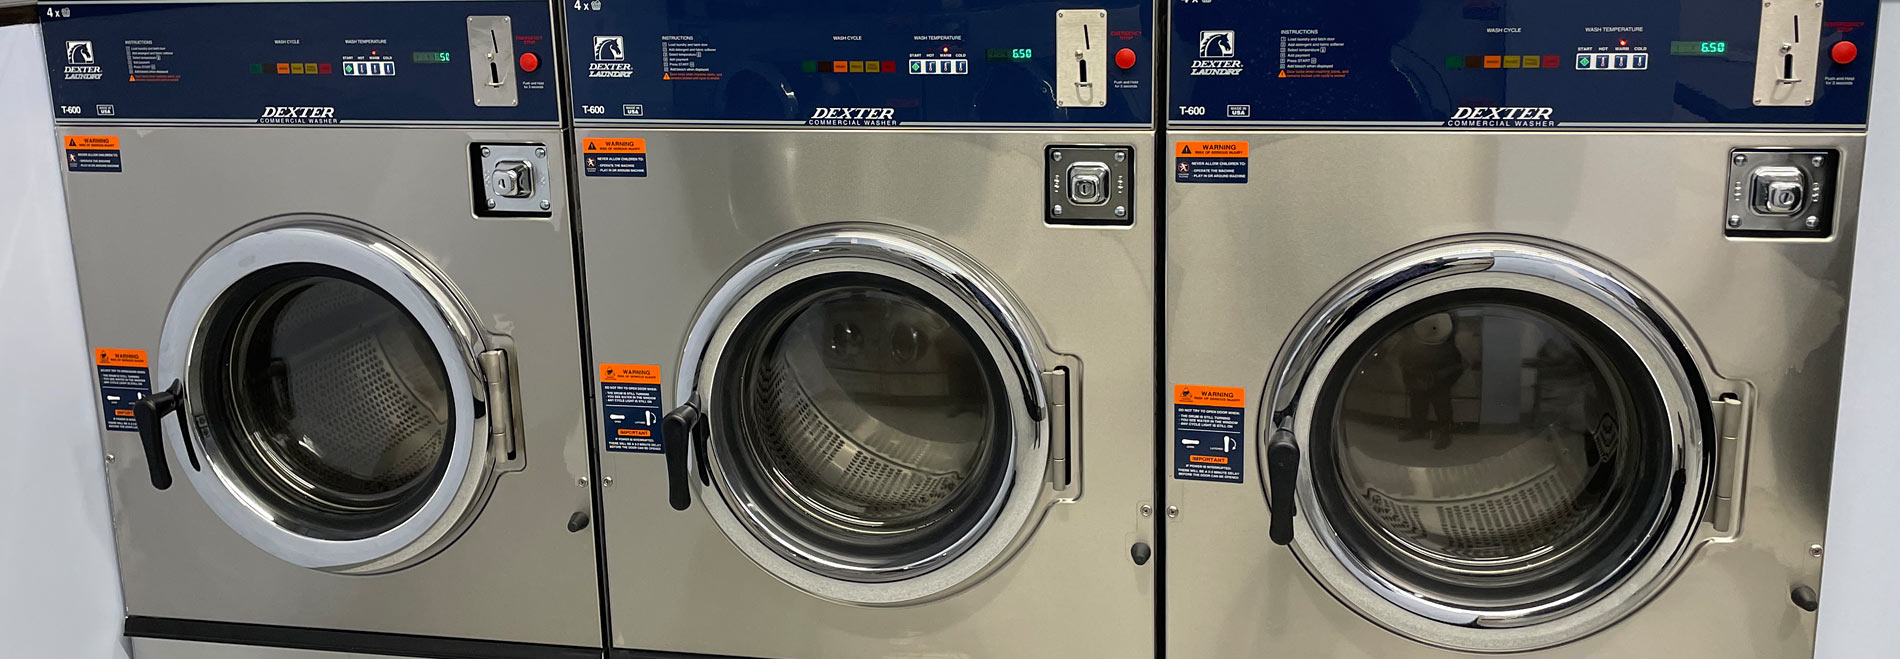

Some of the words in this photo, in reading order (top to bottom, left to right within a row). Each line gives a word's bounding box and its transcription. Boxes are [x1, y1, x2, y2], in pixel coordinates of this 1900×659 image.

[574, 0, 581, 10] 4
[46, 7, 53, 17] 4
[1701, 42, 1725, 52] 6.50
[1012, 49, 1032, 58] 6.50
[61, 105, 81, 114] T-600
[262, 107, 334, 118] DEXTER
[582, 106, 604, 114] T-600
[811, 108, 894, 119] DEXTER
[1179, 106, 1205, 115] T-600
[1451, 107, 1553, 120] DEXTER
